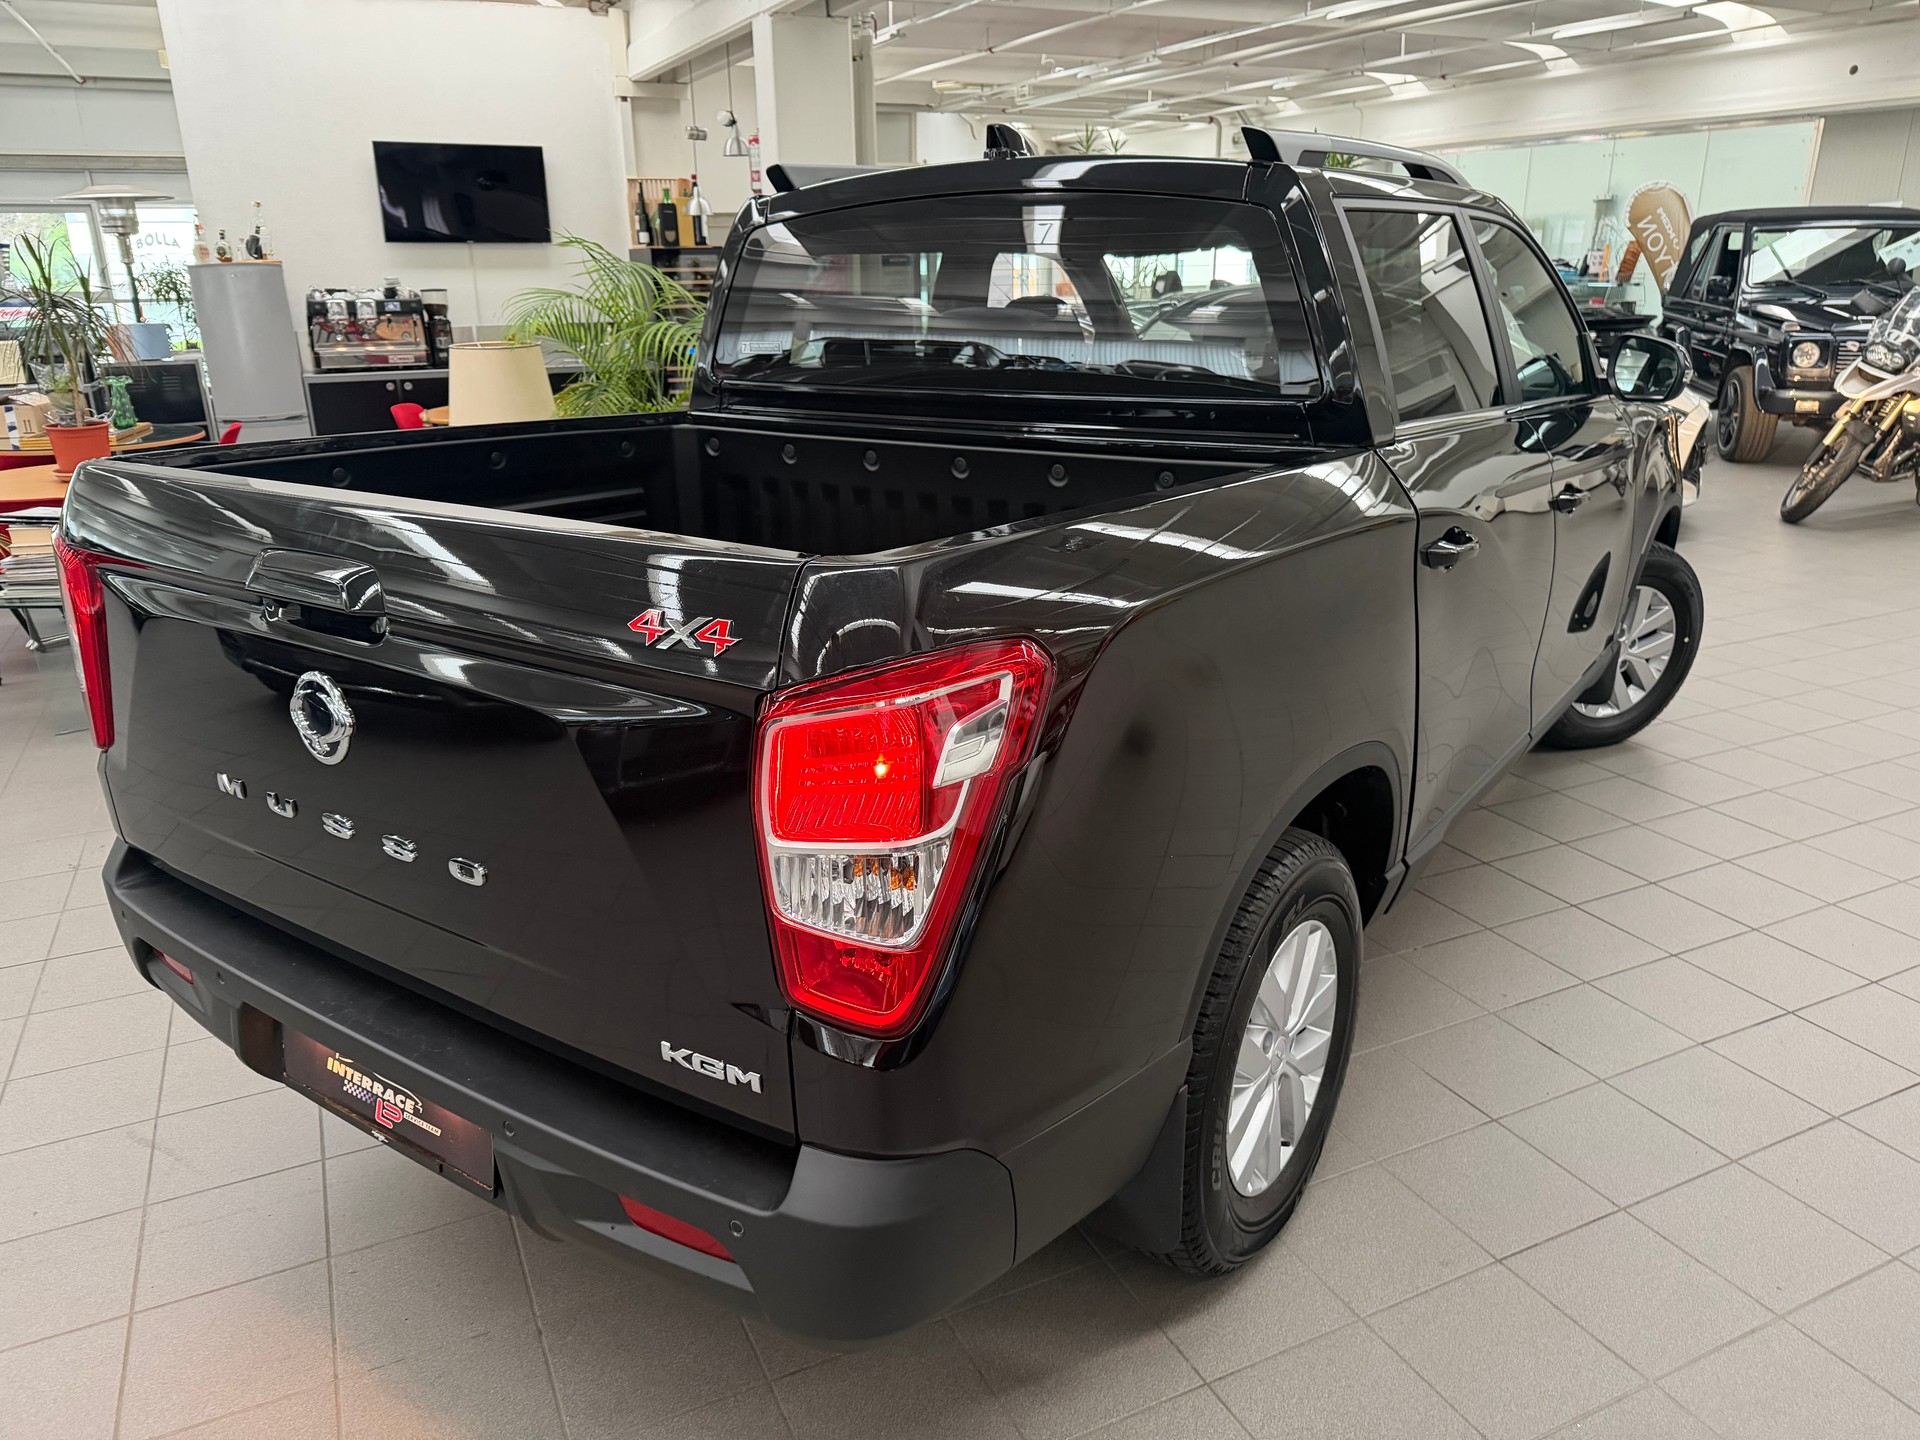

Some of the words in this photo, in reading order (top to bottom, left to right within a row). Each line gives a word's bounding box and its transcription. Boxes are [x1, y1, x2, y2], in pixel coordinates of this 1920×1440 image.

[136, 231, 181, 249] BOLLA
[216, 772, 489, 887] MUSSO
[326, 1056, 416, 1114] INTERRACE
[660, 1040, 763, 1095] KGM
[404, 1112, 425, 1127] SERVICE
[425, 1123, 440, 1134] TEAM
